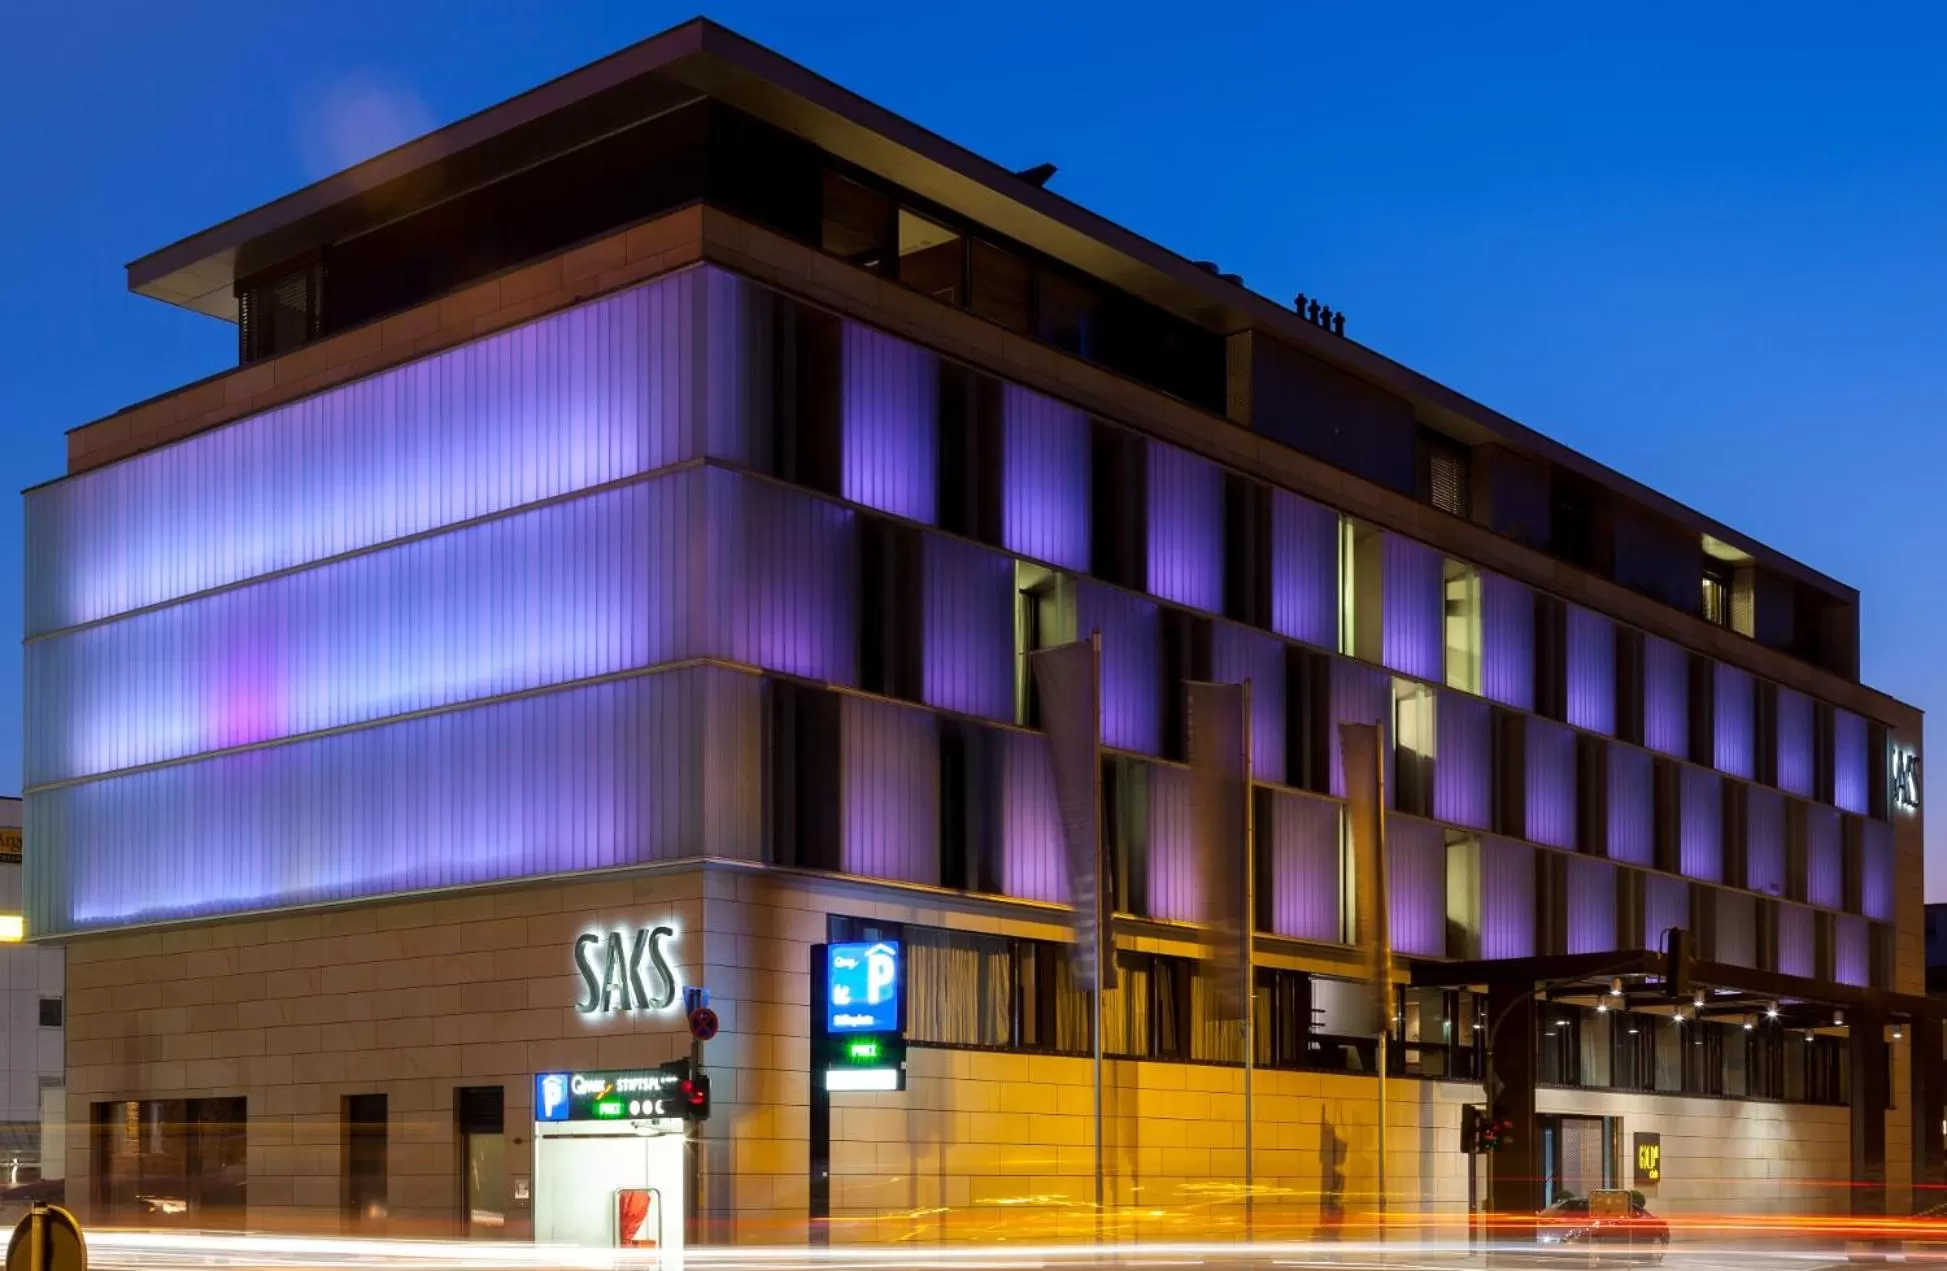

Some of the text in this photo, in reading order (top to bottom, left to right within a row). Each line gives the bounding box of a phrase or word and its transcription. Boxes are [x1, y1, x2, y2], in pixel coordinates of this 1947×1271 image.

[575, 927, 675, 1013] SAKS
[867, 954, 895, 1006] P
[543, 1083, 562, 1117] P
